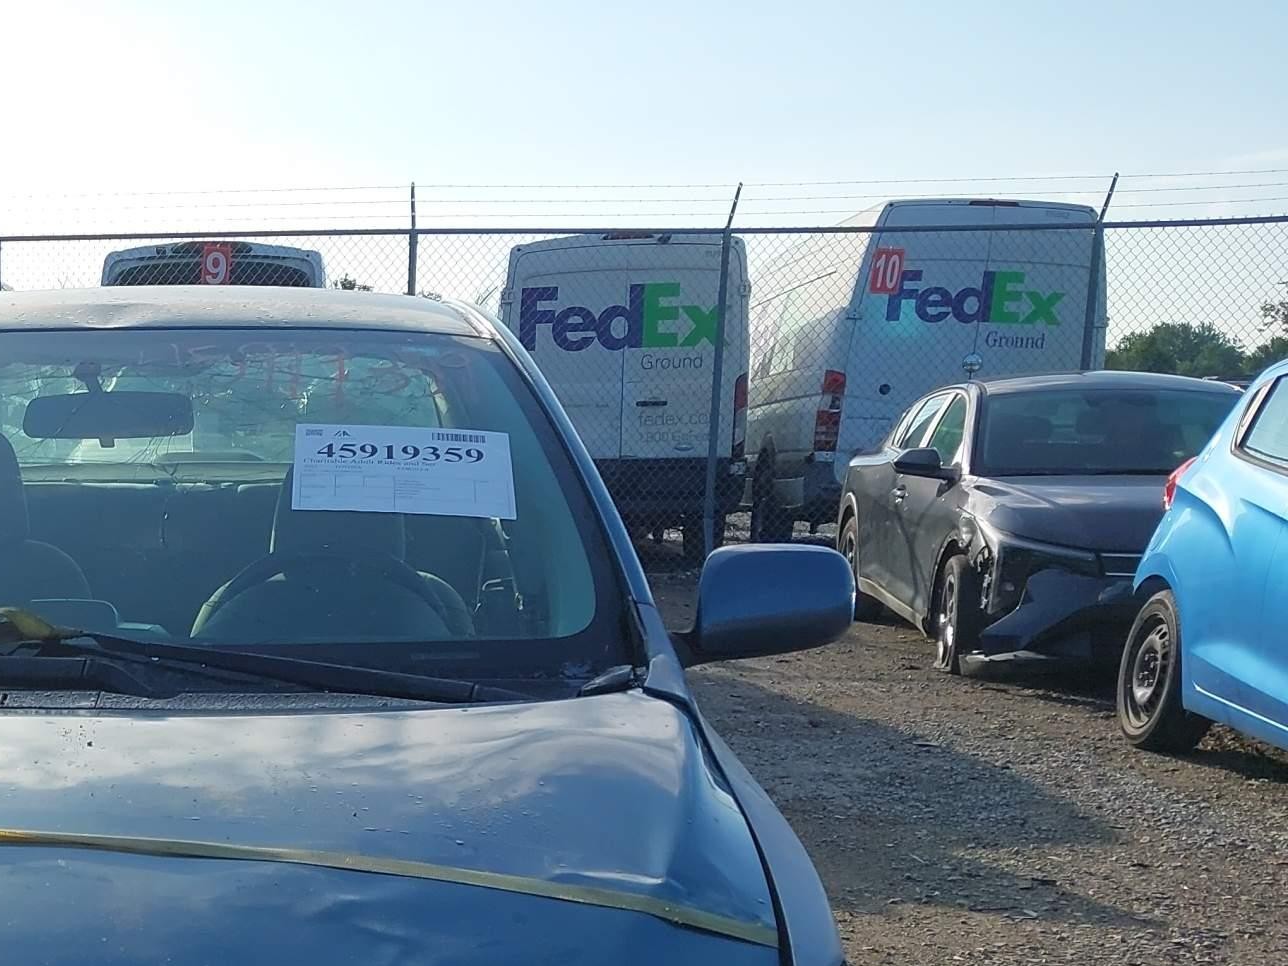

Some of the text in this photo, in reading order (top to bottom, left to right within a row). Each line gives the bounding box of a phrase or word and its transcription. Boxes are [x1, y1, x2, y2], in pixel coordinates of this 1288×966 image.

[205, 251, 227, 285] 9
[875, 253, 900, 289] 10
[885, 269, 1065, 325] FedEx
[519, 282, 729, 351] FedEx
[985, 330, 1046, 350] Ground
[640, 353, 704, 370] Ground
[637, 410, 725, 427] fedex.co
[317, 442, 484, 463] 45919359
